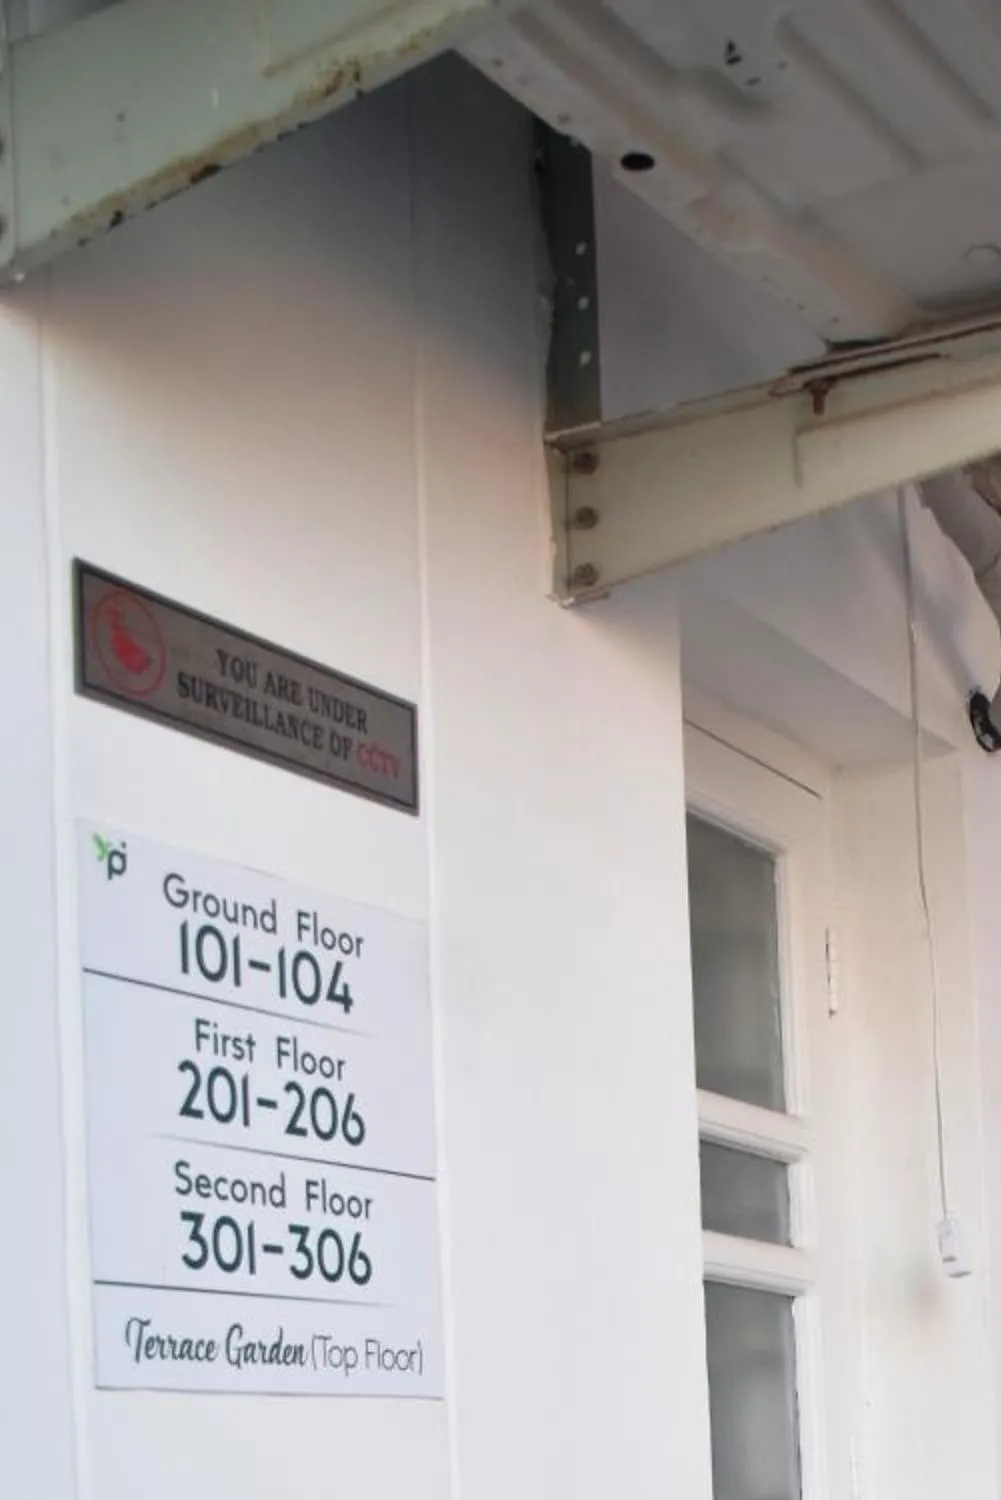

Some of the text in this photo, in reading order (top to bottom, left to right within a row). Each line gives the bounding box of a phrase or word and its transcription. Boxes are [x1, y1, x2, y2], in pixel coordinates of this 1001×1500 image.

[177, 671, 323, 750] SURVEILLANCE
[329, 728, 353, 761] OF
[216, 648, 369, 735] YOU ARE UNDER
[163, 873, 364, 958] Ground Floor
[179, 919, 354, 1014] 101-104
[194, 1018, 346, 1081] First Floor
[178, 1059, 367, 1147] 201-206
[174, 1160, 373, 1220] Second Floor
[180, 1210, 373, 1286] 301-306
[125, 1316, 424, 1377] Terrace Garden (Top Floor)
